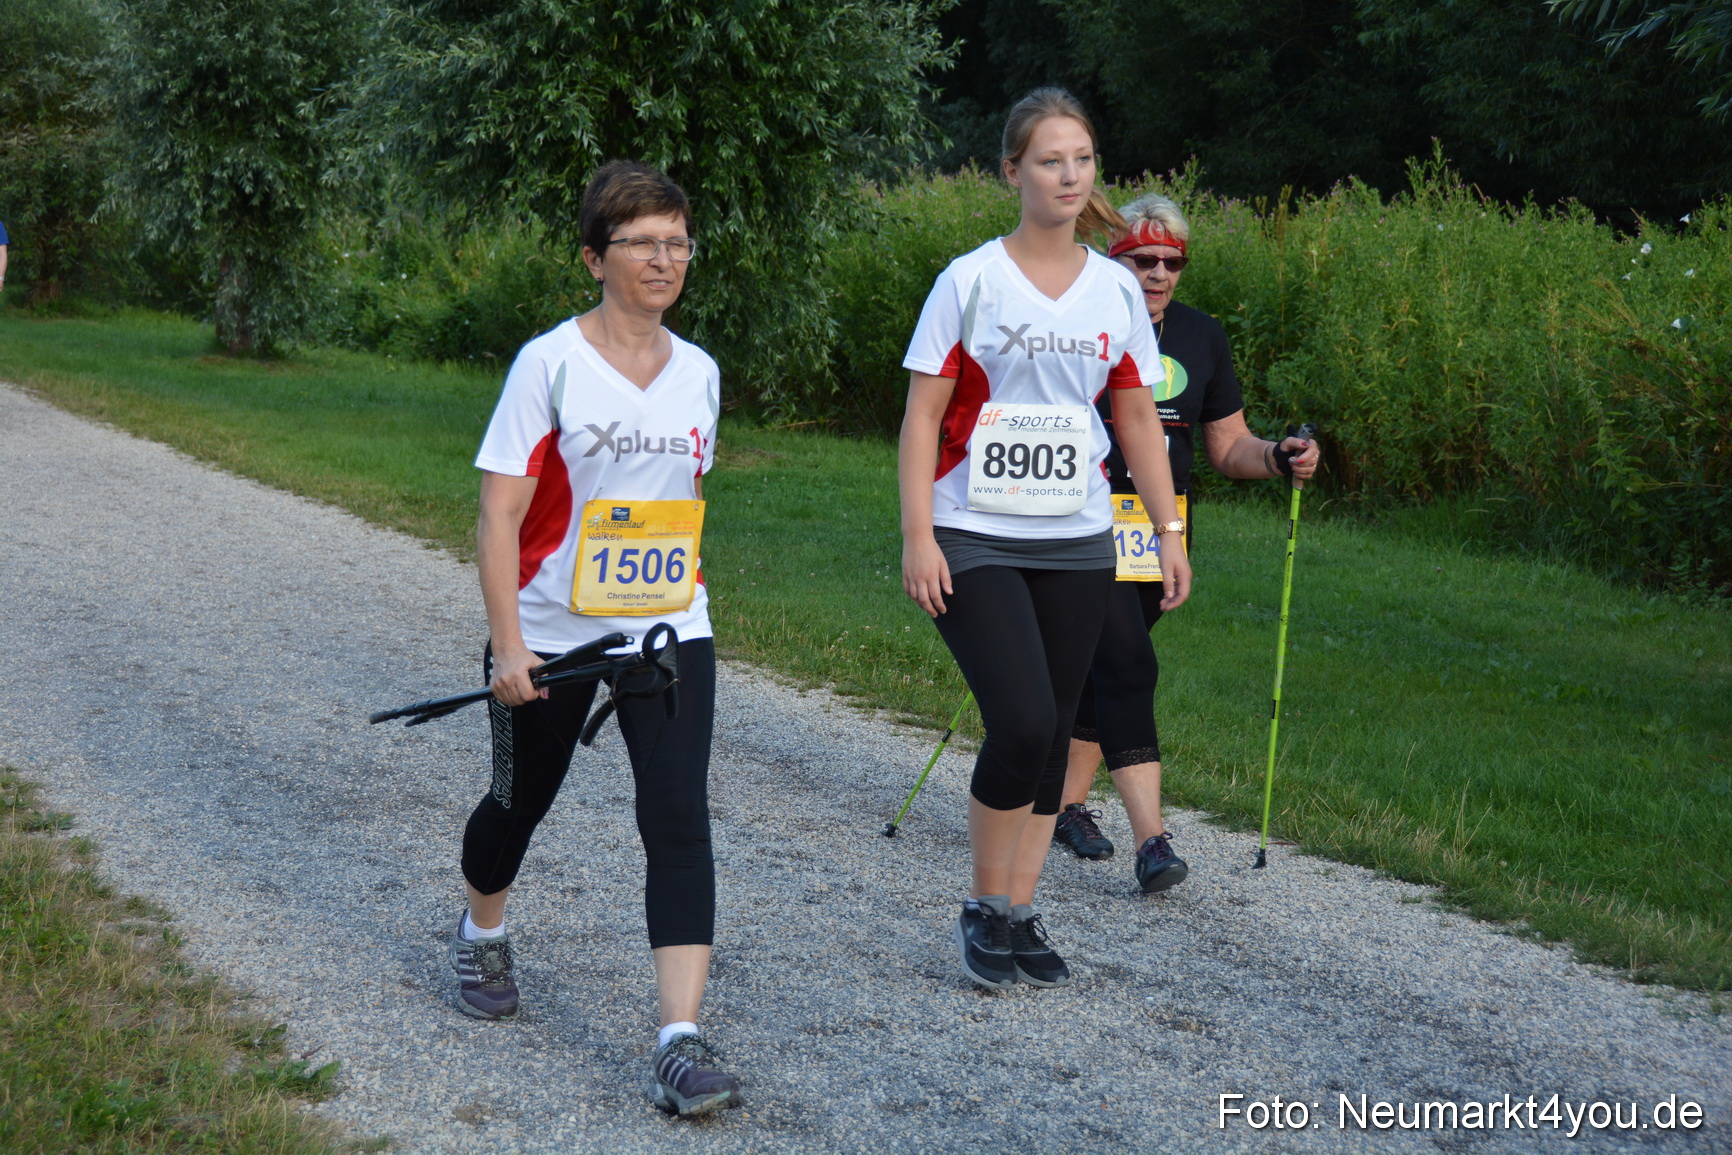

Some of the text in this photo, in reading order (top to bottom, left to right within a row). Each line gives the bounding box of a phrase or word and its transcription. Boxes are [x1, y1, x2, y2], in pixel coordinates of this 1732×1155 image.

[996, 323, 1110, 362] Xplus1
[978, 409, 1073, 430] df-sports
[582, 421, 703, 463] Xplus1
[982, 442, 1077, 481] 8903
[973, 486, 1083, 498] www.df-sports.de
[600, 519, 646, 529] firmenlauf
[592, 547, 686, 585] 1506
[607, 592, 666, 600] Christine Pensel
